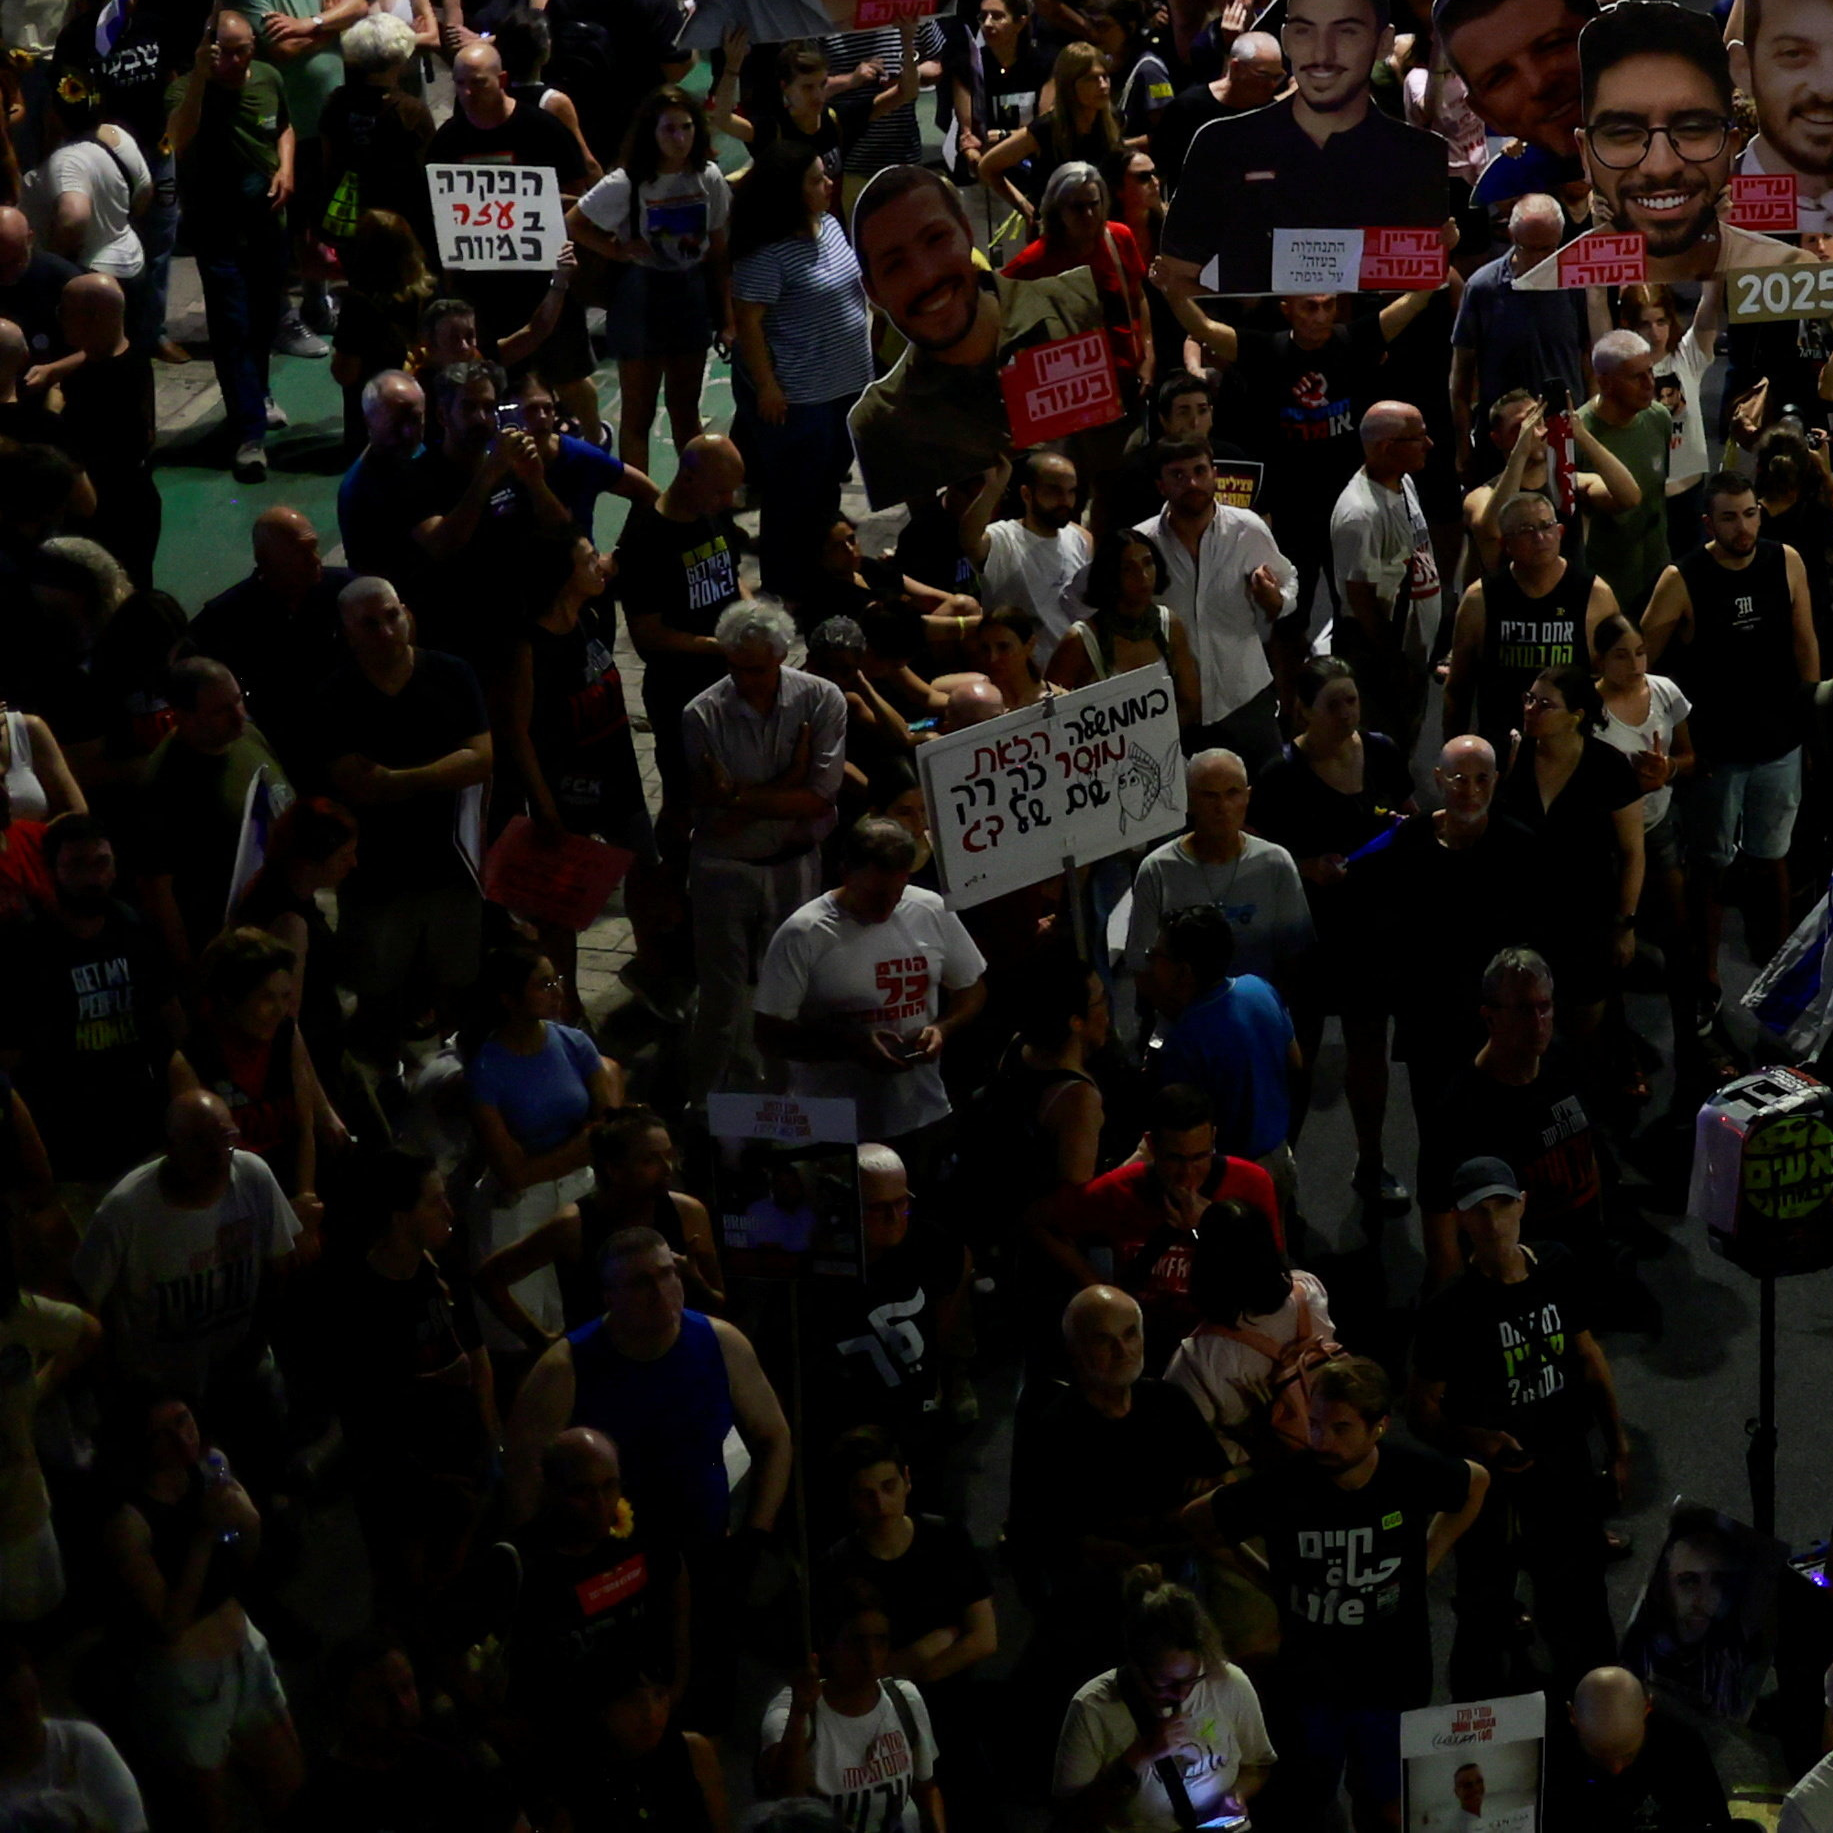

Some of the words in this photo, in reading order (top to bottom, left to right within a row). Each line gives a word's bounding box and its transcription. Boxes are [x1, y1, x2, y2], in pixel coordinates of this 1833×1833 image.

[436, 169, 543, 202] הפקרה
[1736, 179, 1790, 199] עדיין
[452, 201, 515, 230] עזה
[448, 233, 543, 263] כמוות
[1291, 241, 1345, 254] התנחלות
[1383, 232, 1441, 256] עדיין
[1584, 237, 1640, 261] עדיין
[1368, 258, 1441, 278] בעזה.
[1570, 263, 1642, 285] בעזה.
[1037, 338, 1102, 383] עדיין
[1030, 374, 1111, 419] בעזה.
[686, 558, 707, 585] GET
[689, 567, 736, 611] HOME!
[1542, 620, 1574, 644] אתם
[1064, 688, 1169, 746] בממשלה
[1055, 734, 1126, 779] מוסר
[950, 777, 995, 826] רק
[1009, 787, 1052, 835] של
[1065, 779, 1111, 815] שם
[961, 814, 1004, 853] דג
[70, 961, 103, 995] GET
[103, 957, 130, 987] MY
[874, 955, 928, 976] קודם
[874, 973, 929, 1007] כל
